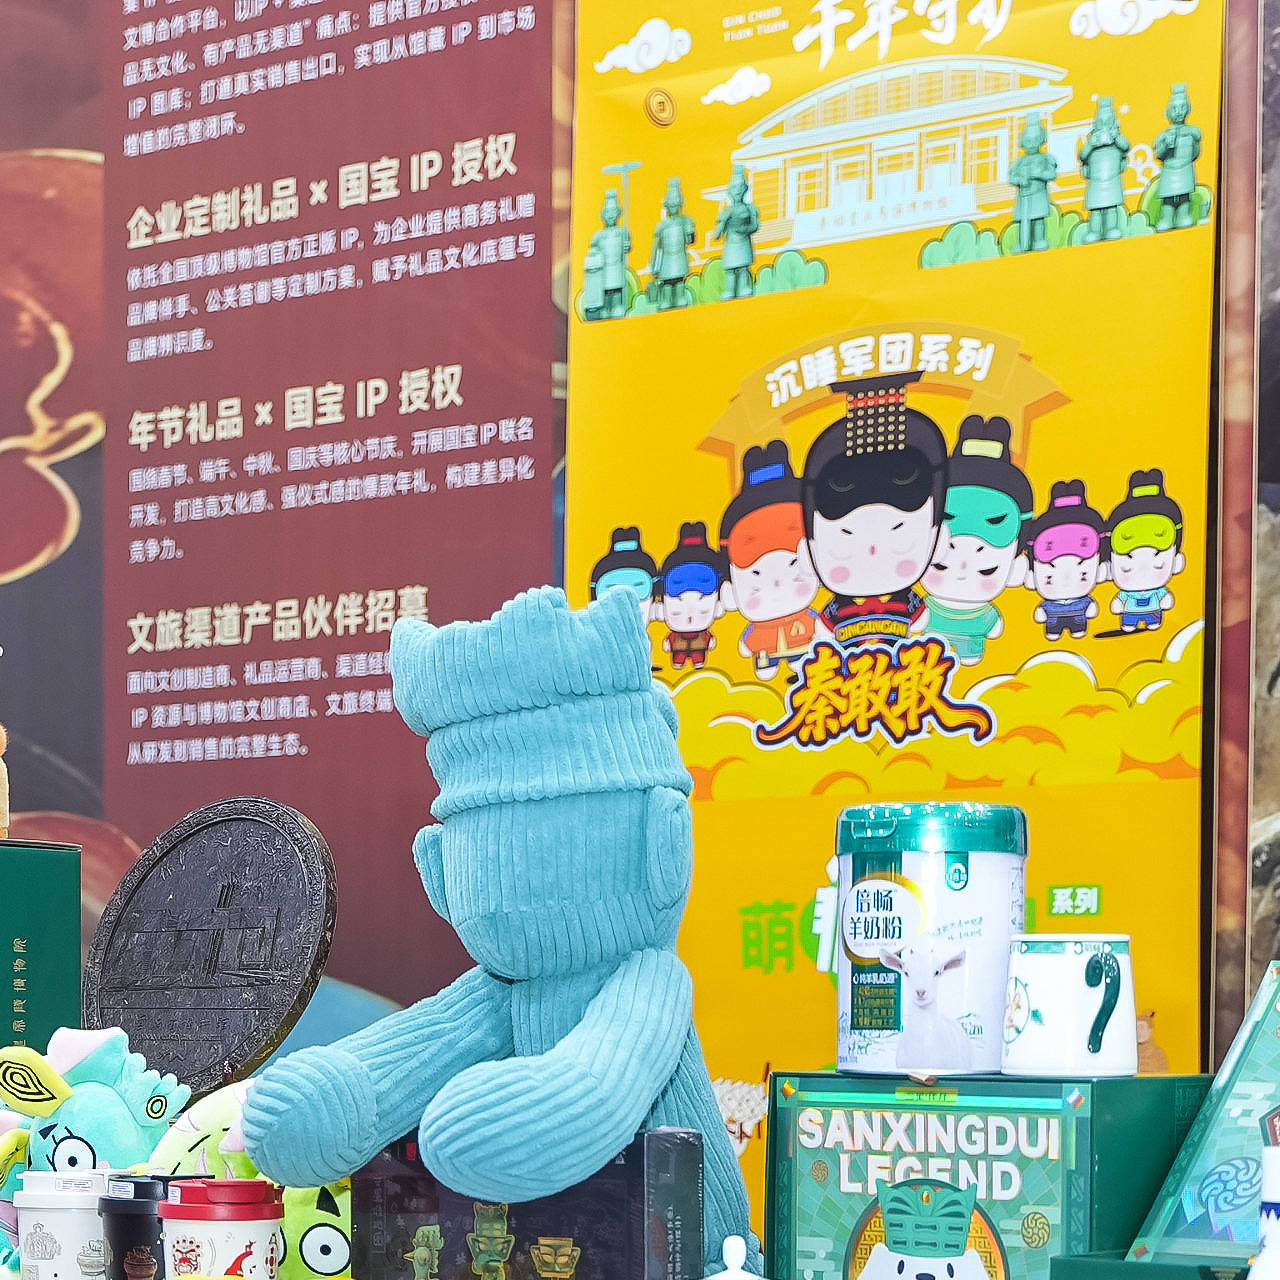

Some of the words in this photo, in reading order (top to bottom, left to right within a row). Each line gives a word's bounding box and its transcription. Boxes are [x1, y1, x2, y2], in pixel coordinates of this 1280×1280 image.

[127, 97, 147, 119] IP
[452, 22, 473, 45] IP
[477, 5, 537, 40] 到市场
[126, 177, 300, 249] 企业定制礼品
[338, 156, 401, 209] 国宝
[410, 151, 443, 192] IP
[451, 133, 518, 187] 授权
[763, 332, 996, 408] 沉睡军团系列
[128, 397, 244, 452] 年节礼品
[285, 382, 345, 431] 国宝
[356, 378, 388, 418] IP
[398, 364, 463, 415] 授权
[131, 706, 149, 728] IP
[856, 889, 894, 913] 倍畅
[1051, 886, 1098, 914] 系列
[738, 900, 795, 975] 萌
[849, 916, 902, 940] 羊奶粉
[797, 1108, 1061, 1161] SANXINGDUI
[838, 1153, 1022, 1202] LEGEND
